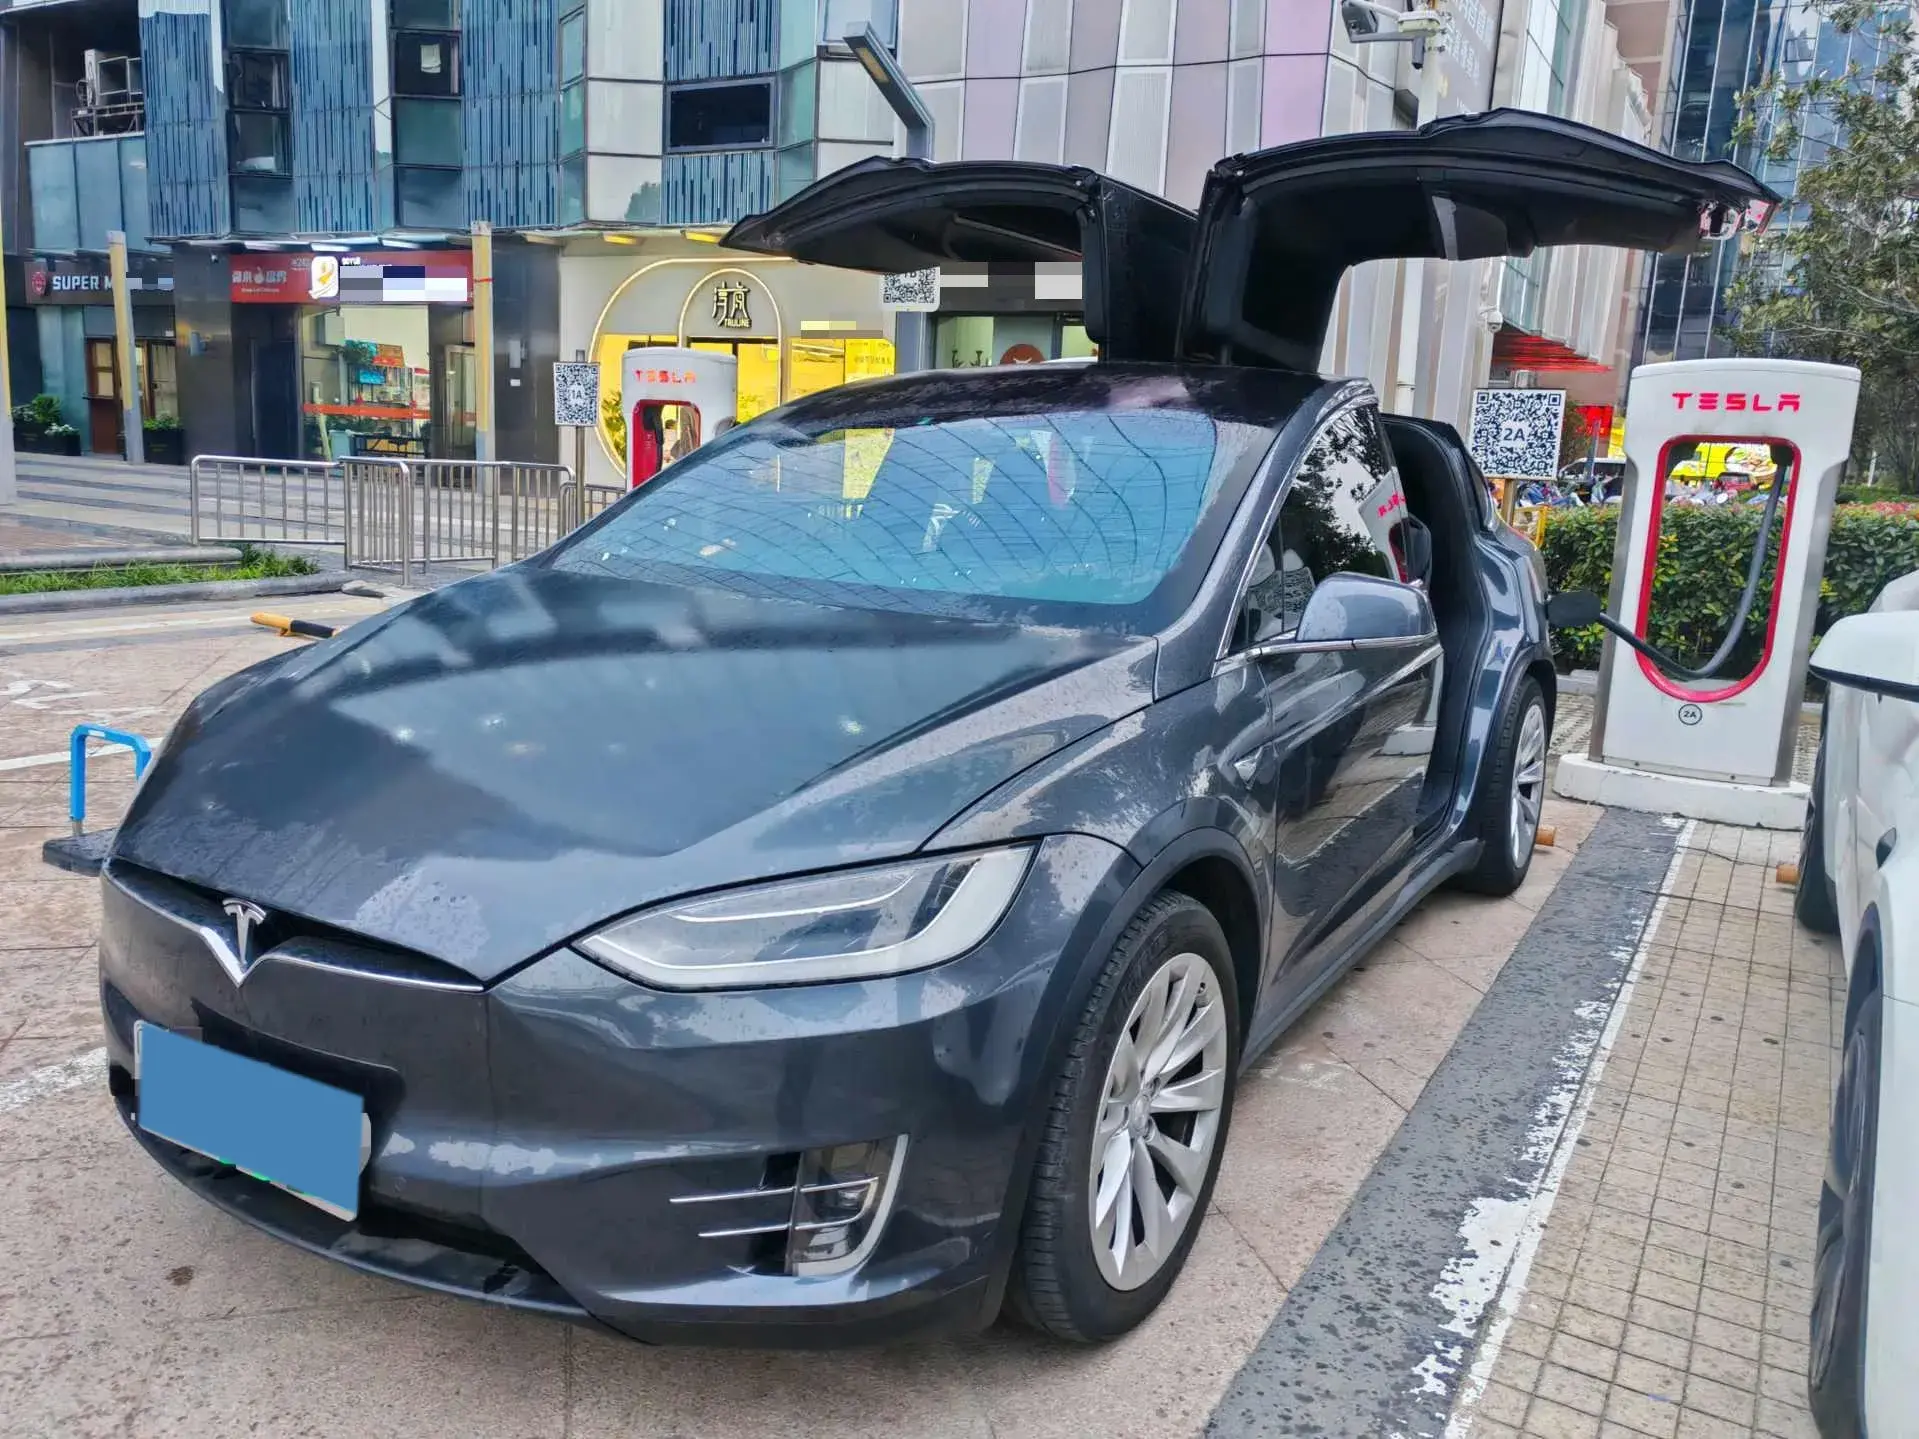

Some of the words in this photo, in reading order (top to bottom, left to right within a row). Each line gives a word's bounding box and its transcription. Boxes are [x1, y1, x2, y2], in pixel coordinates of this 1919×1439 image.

[52, 275, 100, 291] SUPER
[632, 368, 697, 384] TESLA
[1671, 392, 1801, 412] TESLA
[1503, 427, 1526, 442] 2A
[1683, 710, 1697, 719] 2A
